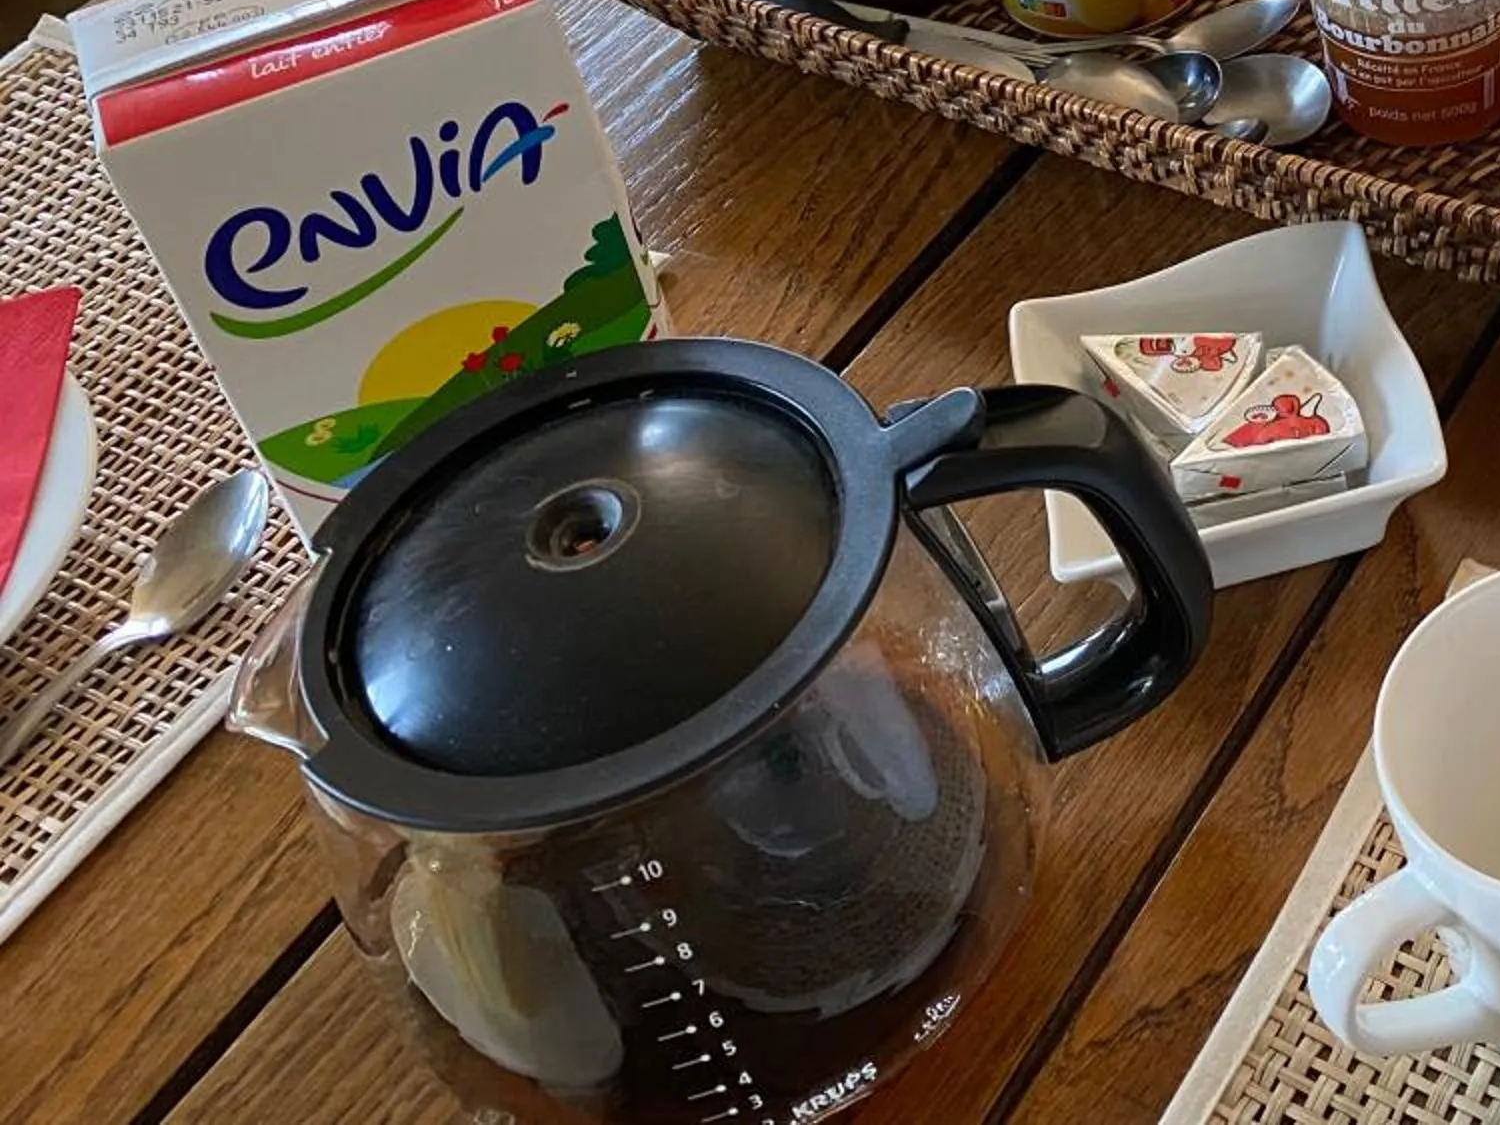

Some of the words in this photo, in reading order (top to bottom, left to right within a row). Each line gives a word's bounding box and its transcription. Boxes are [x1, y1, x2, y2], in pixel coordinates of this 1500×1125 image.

[1387, 13, 1426, 35] du
[249, 51, 302, 79] lait
[637, 859, 663, 881] 10
[662, 908, 678, 928] 9
[677, 942, 694, 960] 8
[691, 978, 705, 996] 7
[708, 1011, 724, 1028] 6
[722, 1040, 737, 1056] 5
[738, 1071, 752, 1085] 4
[791, 1060, 878, 1119] KRUPS
[748, 1094, 763, 1110] 3
